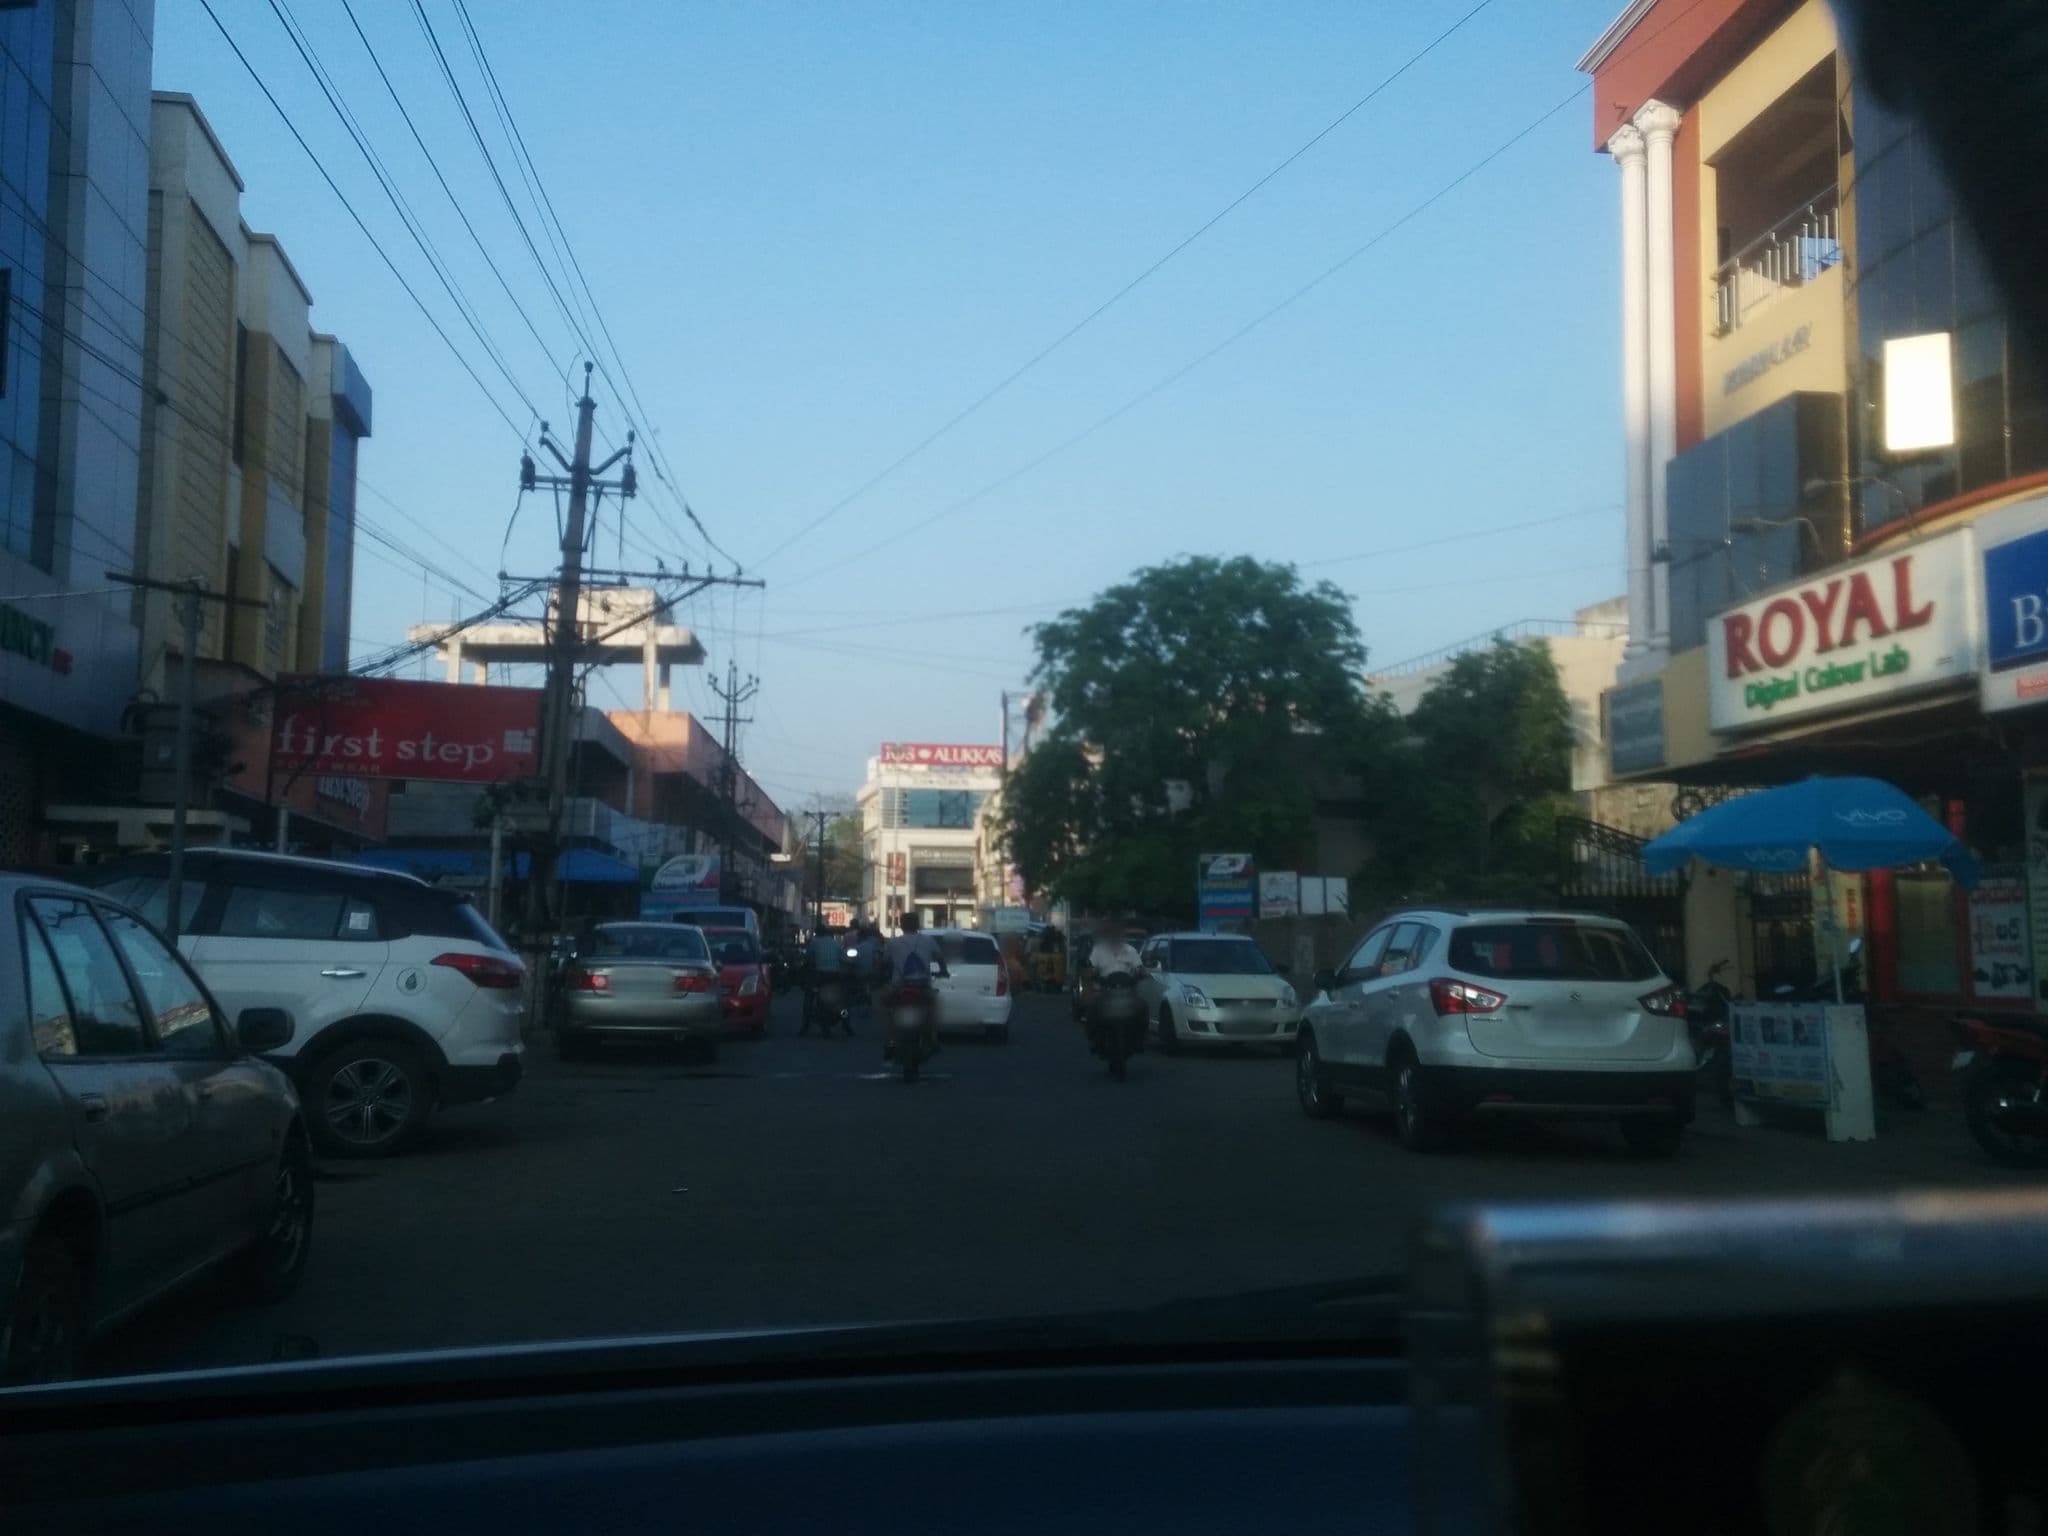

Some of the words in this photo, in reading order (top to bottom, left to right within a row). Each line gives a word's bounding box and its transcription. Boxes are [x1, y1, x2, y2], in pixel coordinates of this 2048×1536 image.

[1723, 556, 1935, 678] ROYAL
[1744, 671, 1798, 709] Digital
[1805, 661, 1867, 692] Colour
[1870, 644, 1911, 677] Lab
[277, 713, 384, 758] first
[396, 731, 495, 771] step
[934, 747, 1002, 764] ALUKKAS
